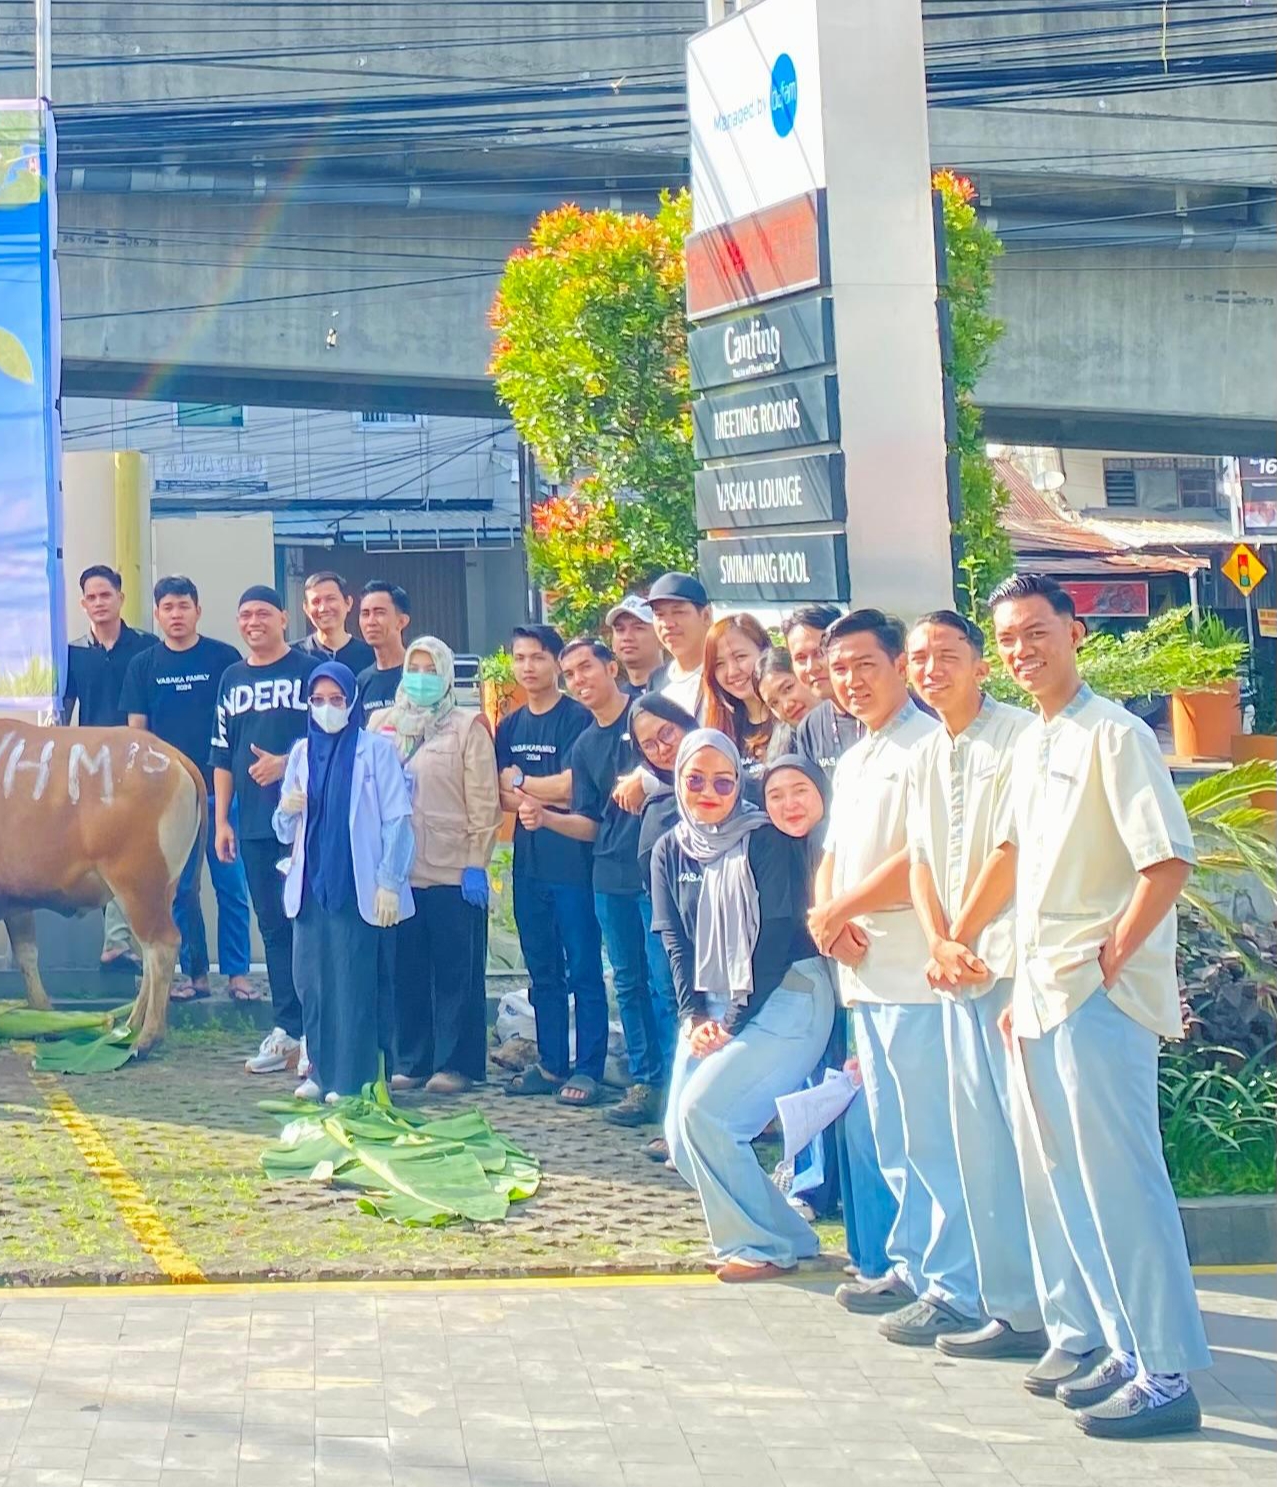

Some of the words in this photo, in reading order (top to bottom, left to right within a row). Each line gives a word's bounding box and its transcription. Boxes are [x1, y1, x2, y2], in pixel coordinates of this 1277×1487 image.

[725, 320, 780, 364] Canting
[714, 405, 758, 440] MEETING
[759, 398, 800, 433] ROOMS
[716, 480, 757, 511] VASAKA
[758, 475, 803, 508] LOUNGE
[720, 553, 777, 584] SWIMMING
[779, 552, 810, 584] POOL
